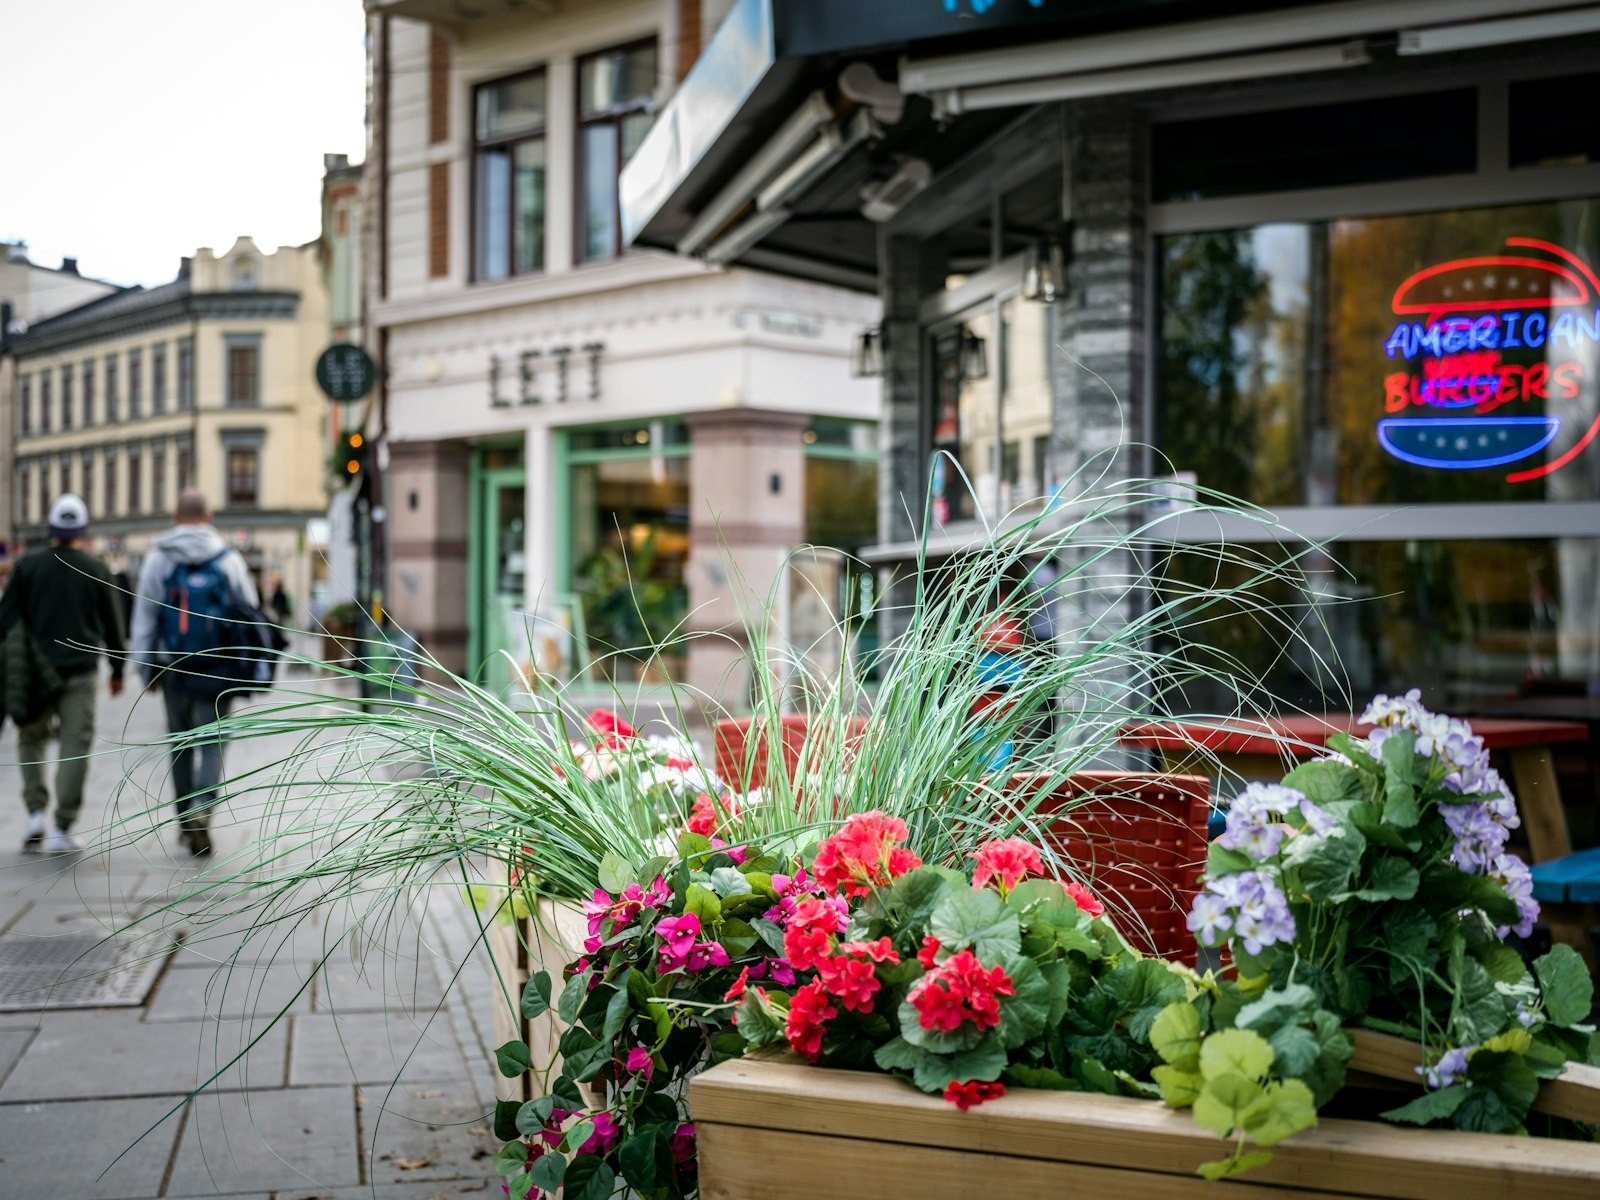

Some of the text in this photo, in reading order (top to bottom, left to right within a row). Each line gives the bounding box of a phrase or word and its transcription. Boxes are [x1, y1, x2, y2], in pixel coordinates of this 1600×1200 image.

[1385, 311, 1600, 359] AMERICAN
[489, 342, 604, 408] LETT
[1384, 361, 1582, 413] BURGERS
